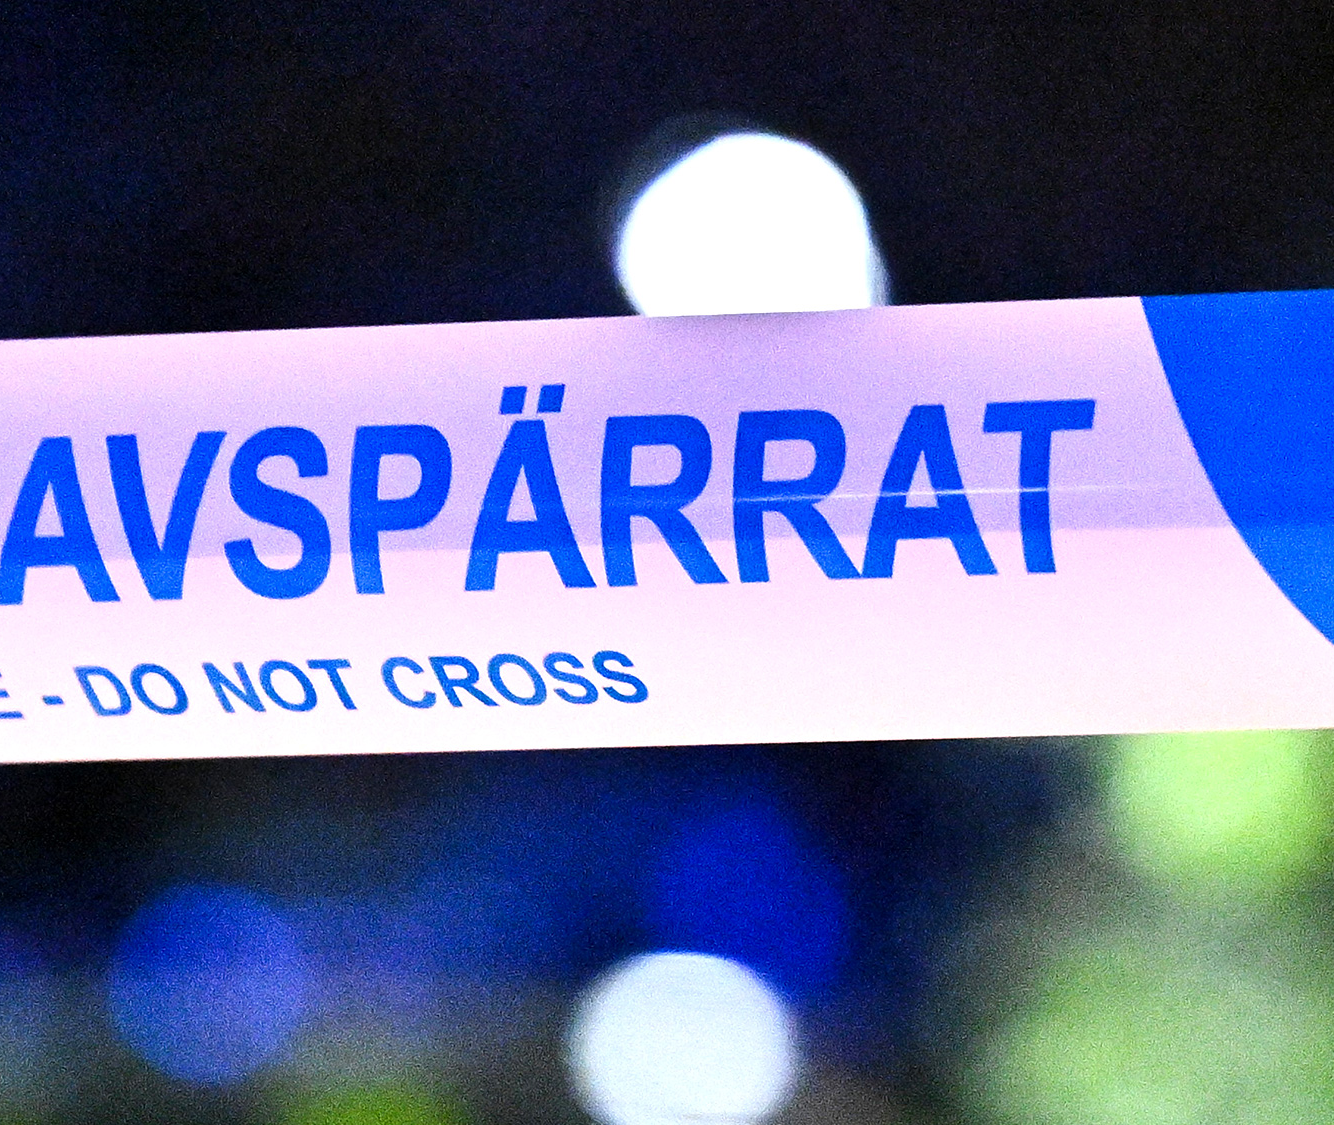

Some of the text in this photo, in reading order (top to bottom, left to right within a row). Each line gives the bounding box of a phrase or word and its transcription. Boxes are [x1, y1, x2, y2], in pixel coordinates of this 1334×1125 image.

[42, 694, 64, 706] -
[74, 662, 190, 718] DO
[203, 657, 357, 714] NOT
[380, 649, 650, 710] CROSS
